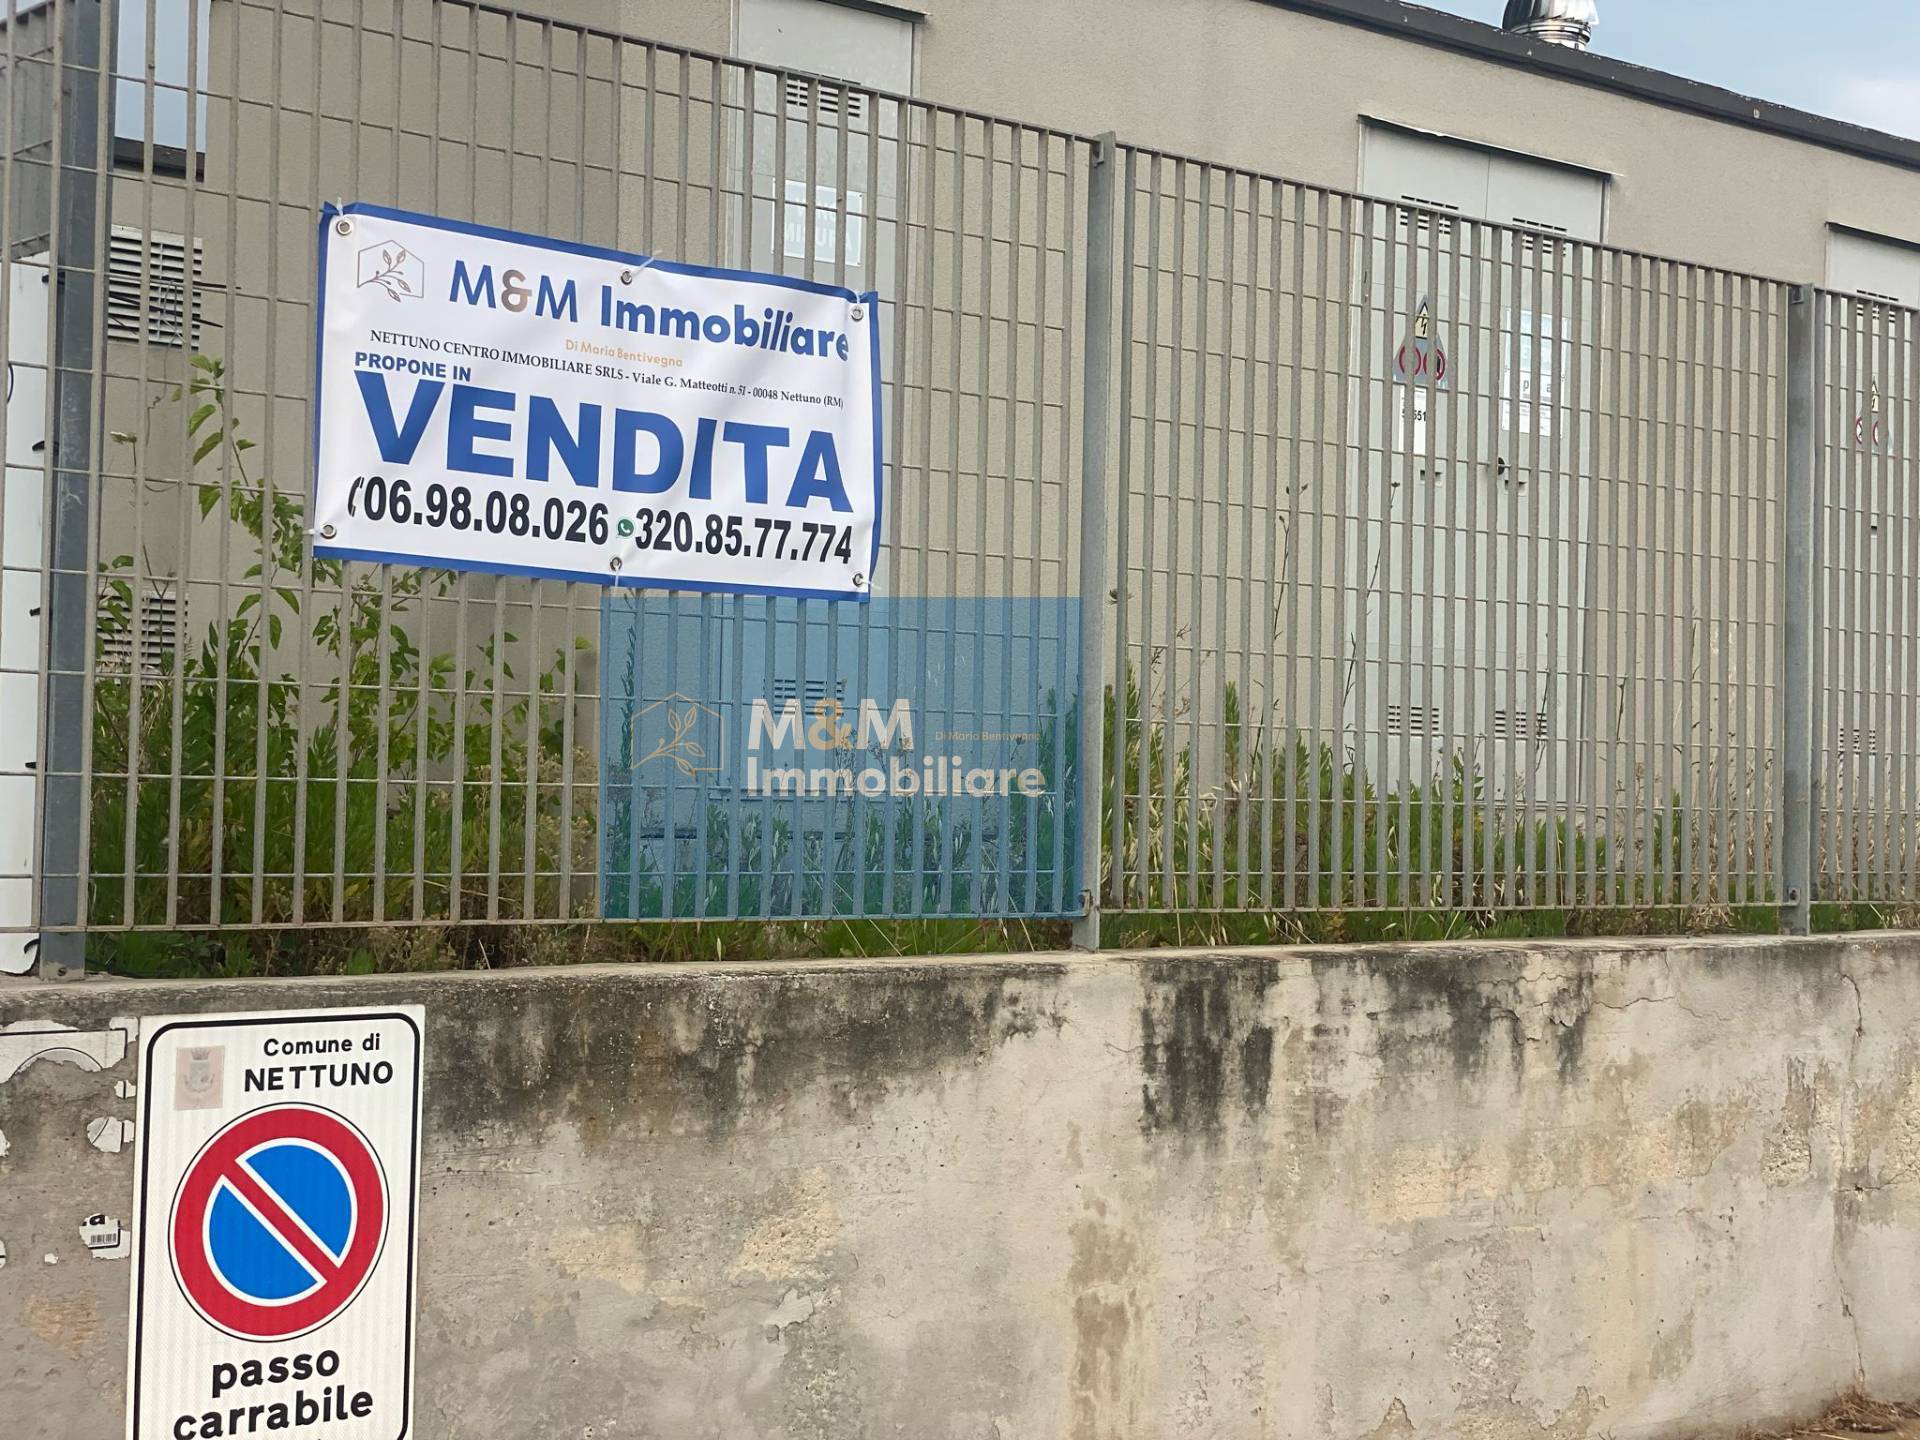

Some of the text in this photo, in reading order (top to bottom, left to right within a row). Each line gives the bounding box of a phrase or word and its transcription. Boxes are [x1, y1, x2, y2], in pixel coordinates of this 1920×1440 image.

[449, 259, 849, 362] M&M Immobiliare
[355, 351, 471, 382] PROPONE IN
[370, 329, 440, 351] NETTUNO
[443, 341, 500, 360] CENTRO
[501, 351, 592, 375] IMMOBILIARE
[595, 365, 624, 380] SRLS
[631, 371, 662, 386] Viale
[664, 375, 678, 388] G.
[680, 378, 728, 393] Matteotti
[753, 387, 778, 400] 00048
[781, 390, 822, 404] Nettuno
[823, 394, 844, 409] (RM)
[565, 339, 580, 352] Di
[617, 347, 683, 369] Bentivegna
[354, 370, 854, 513] VENDITA
[363, 476, 853, 564] 06.98.08.026 320.85.77.774
[263, 1033, 381, 1057] Comune di
[244, 1061, 394, 1092] NETTUNO
[212, 1350, 340, 1398] passo
[173, 1385, 373, 1440] carrabile
